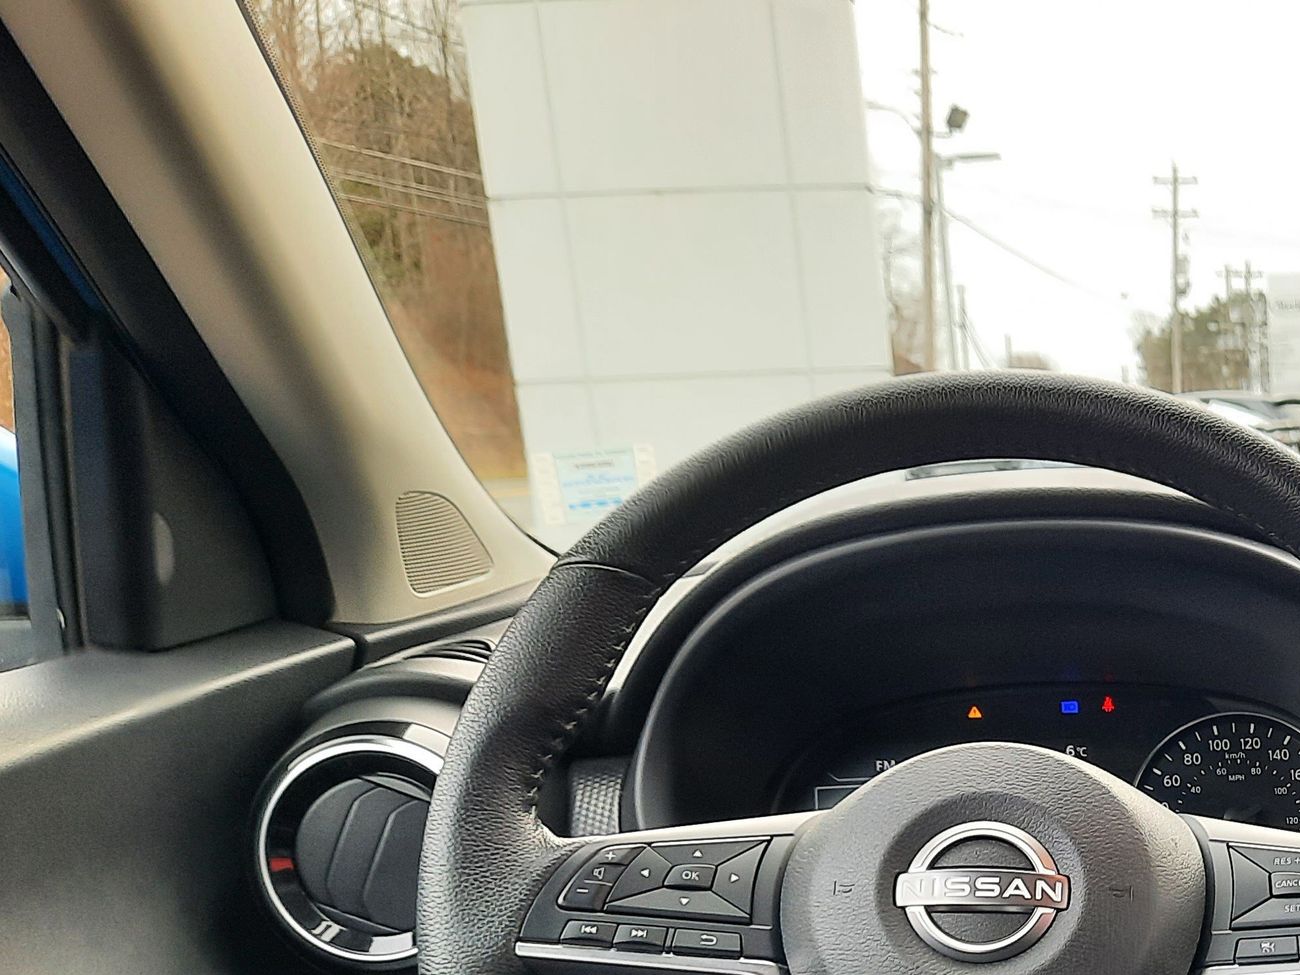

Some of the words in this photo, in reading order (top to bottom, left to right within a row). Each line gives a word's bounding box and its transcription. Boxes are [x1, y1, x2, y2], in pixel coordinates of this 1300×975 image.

[1208, 739, 1230, 751] 100
[1240, 738, 1261, 749] 120
[1183, 753, 1201, 766] 80
[1225, 751, 1246, 759] km/h
[1268, 749, 1290, 761] 140
[1250, 767, 1261, 775] 80
[1163, 775, 1181, 787] 60
[1190, 786, 1201, 794] 40
[1274, 787, 1288, 795] 100
[1286, 817, 1299, 825] 120
[1273, 857, 1292, 865] RES
[682, 870, 700, 881] OK
[900, 874, 1063, 903] NISSAN
[1284, 903, 1300, 913] SET
